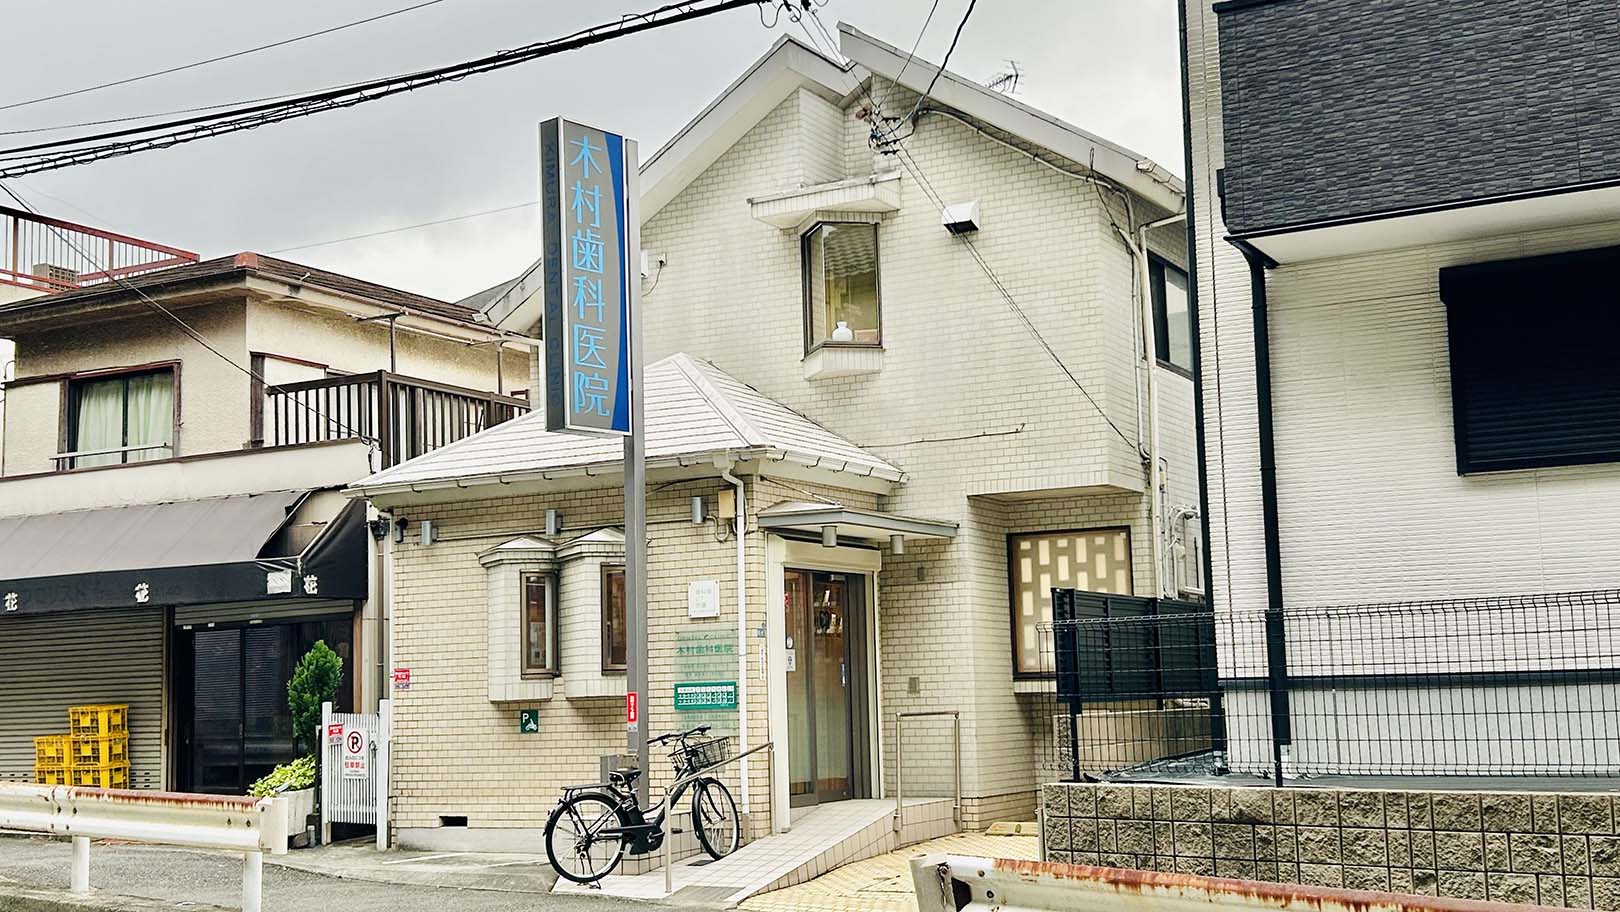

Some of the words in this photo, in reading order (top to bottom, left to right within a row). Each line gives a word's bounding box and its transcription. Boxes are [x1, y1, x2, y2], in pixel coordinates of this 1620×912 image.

[544, 142, 557, 223] KIMURA
[547, 241, 561, 326] DENTAL
[569, 134, 610, 416] 木村歯科医院
[549, 337, 562, 408] CLINIC
[135, 582, 150, 603] 花
[303, 574, 318, 595] 花
[4, 592, 18, 611] 花
[675, 645, 734, 655] 木村歯科医院
[522, 712, 529, 723] P
